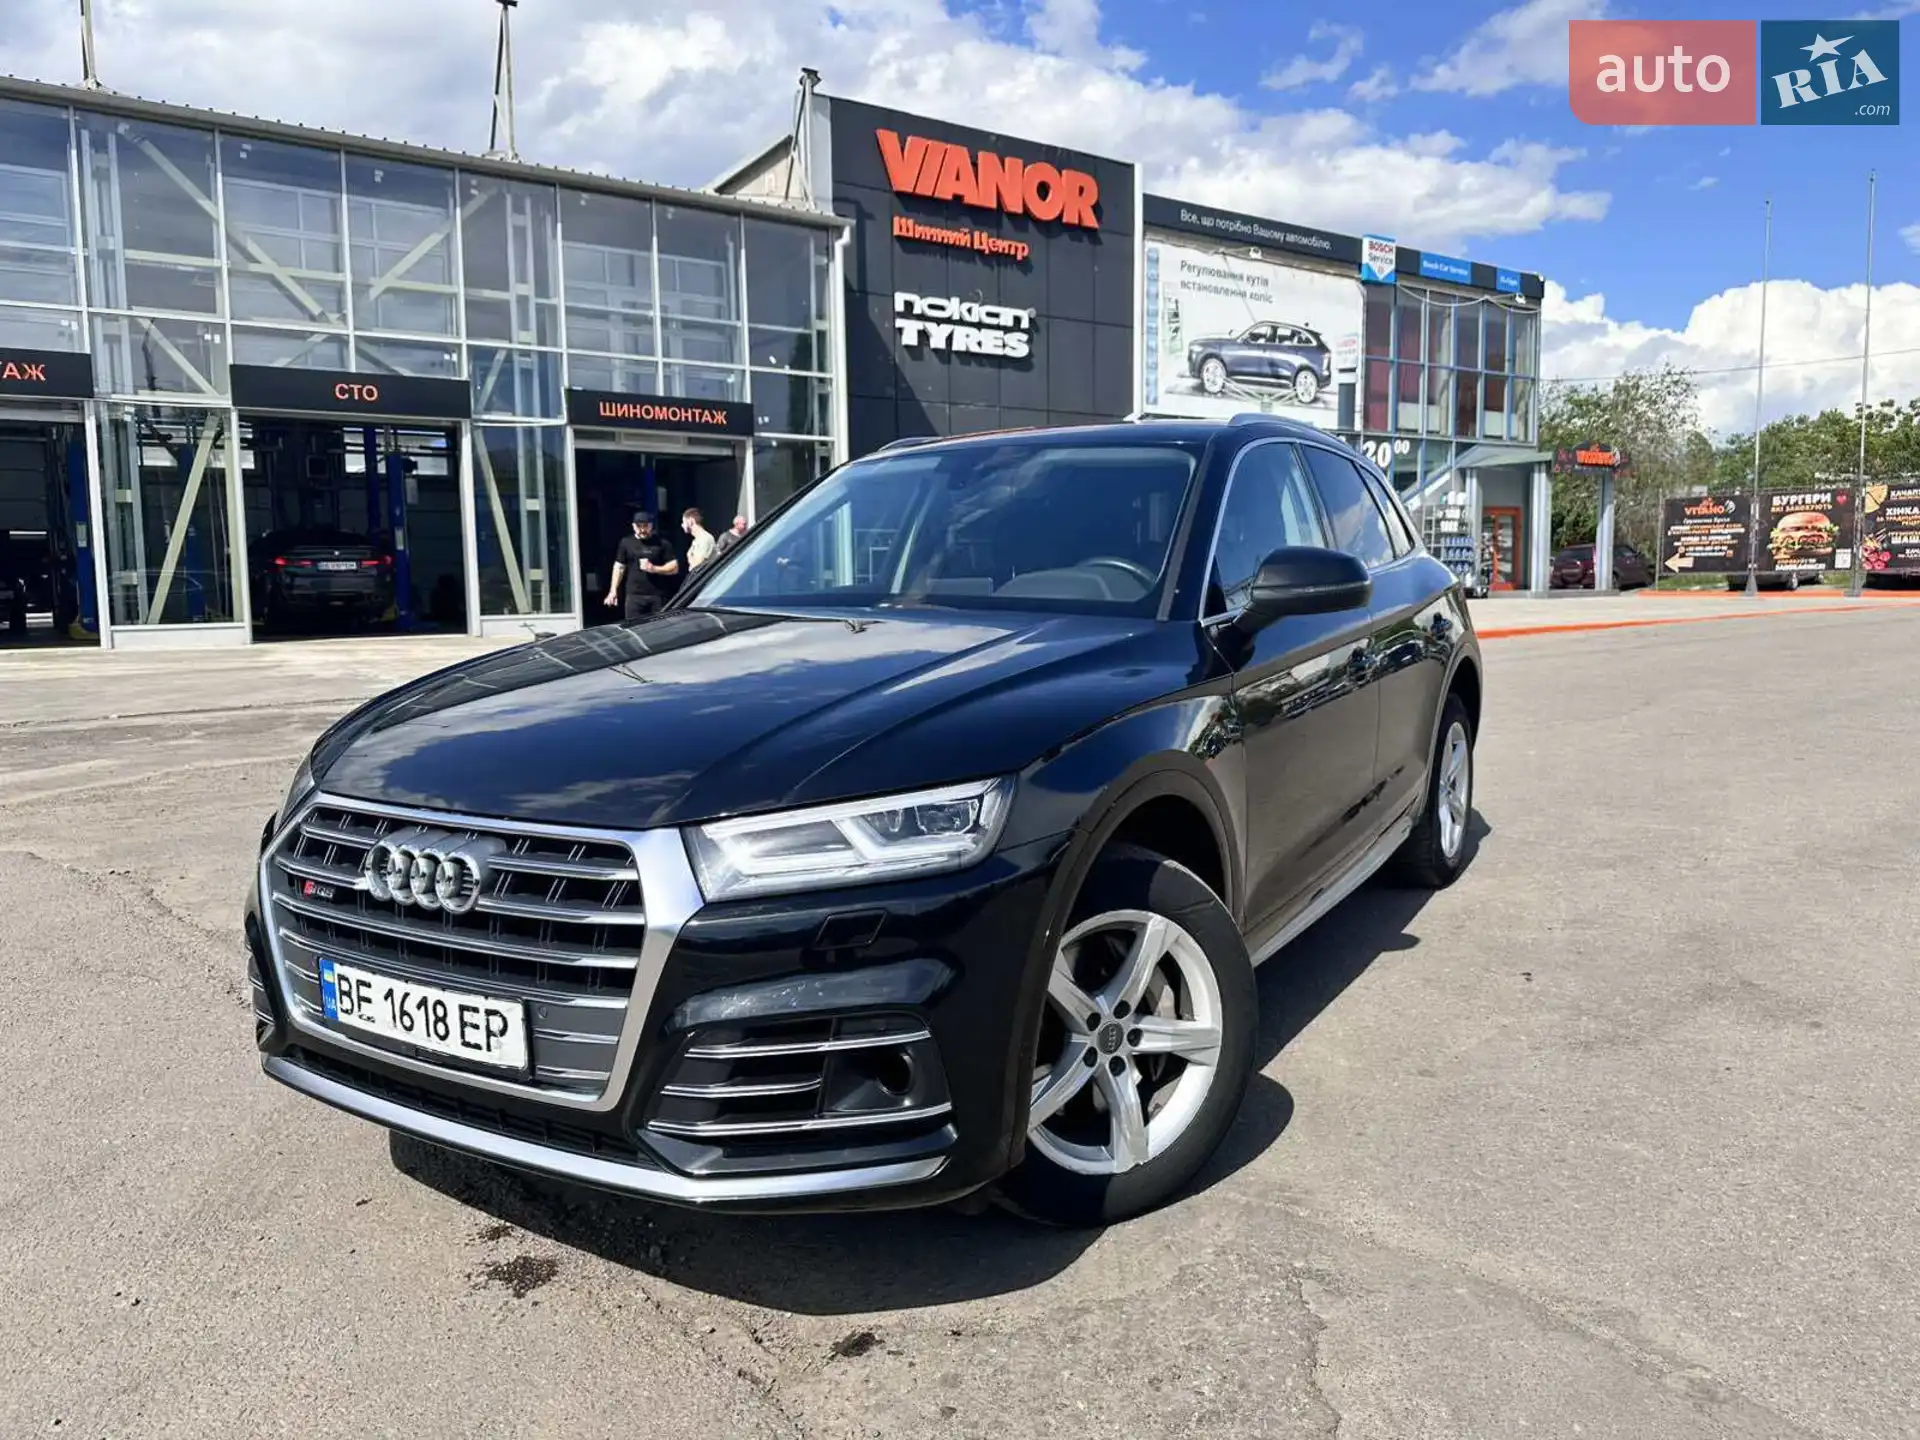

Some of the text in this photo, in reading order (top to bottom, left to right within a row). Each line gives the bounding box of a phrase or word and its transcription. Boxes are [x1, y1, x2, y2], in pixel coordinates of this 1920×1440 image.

[875, 128, 1099, 230] VIANOR
[892, 215, 1030, 261] Шинний Центр
[1368, 240, 1393, 253] BOSCH
[1367, 253, 1393, 265] Service
[1180, 259, 1269, 287] Регулювання кутів
[1180, 280, 1273, 304] встановлення коліс
[893, 318, 1030, 359] TYRES
[0, 361, 46, 381] АЖ
[335, 383, 378, 401] СТО
[599, 401, 728, 425] ШИНОМОНТАЖ
[1772, 492, 1832, 506] БУРГЕРИ
[384, 988, 450, 1041] 1618
[458, 1003, 509, 1052] EP
